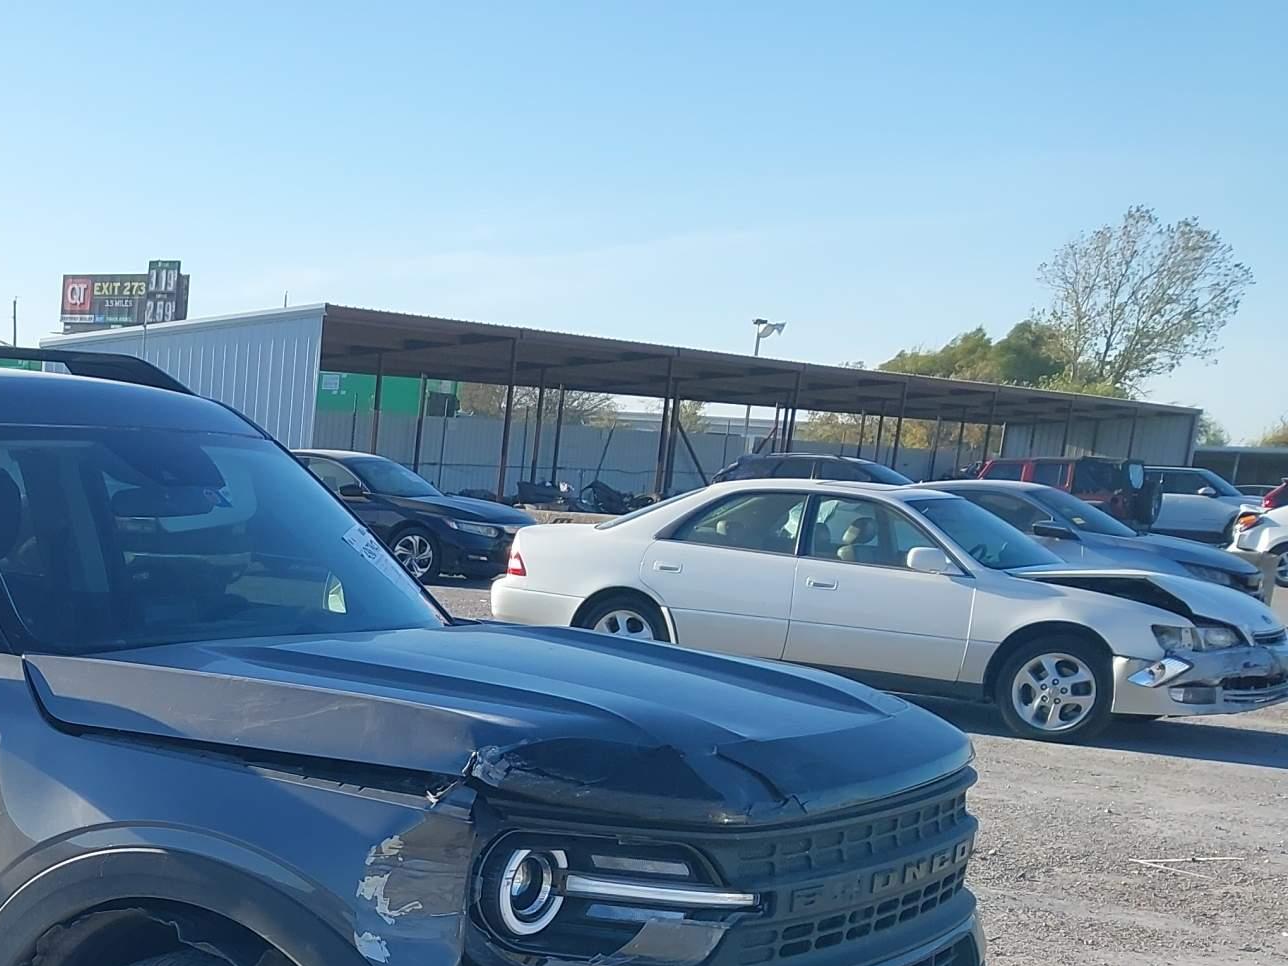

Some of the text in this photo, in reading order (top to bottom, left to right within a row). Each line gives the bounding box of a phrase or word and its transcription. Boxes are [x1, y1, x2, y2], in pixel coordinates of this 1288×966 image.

[68, 283, 87, 305] QT
[94, 282, 146, 295] EXIT 273
